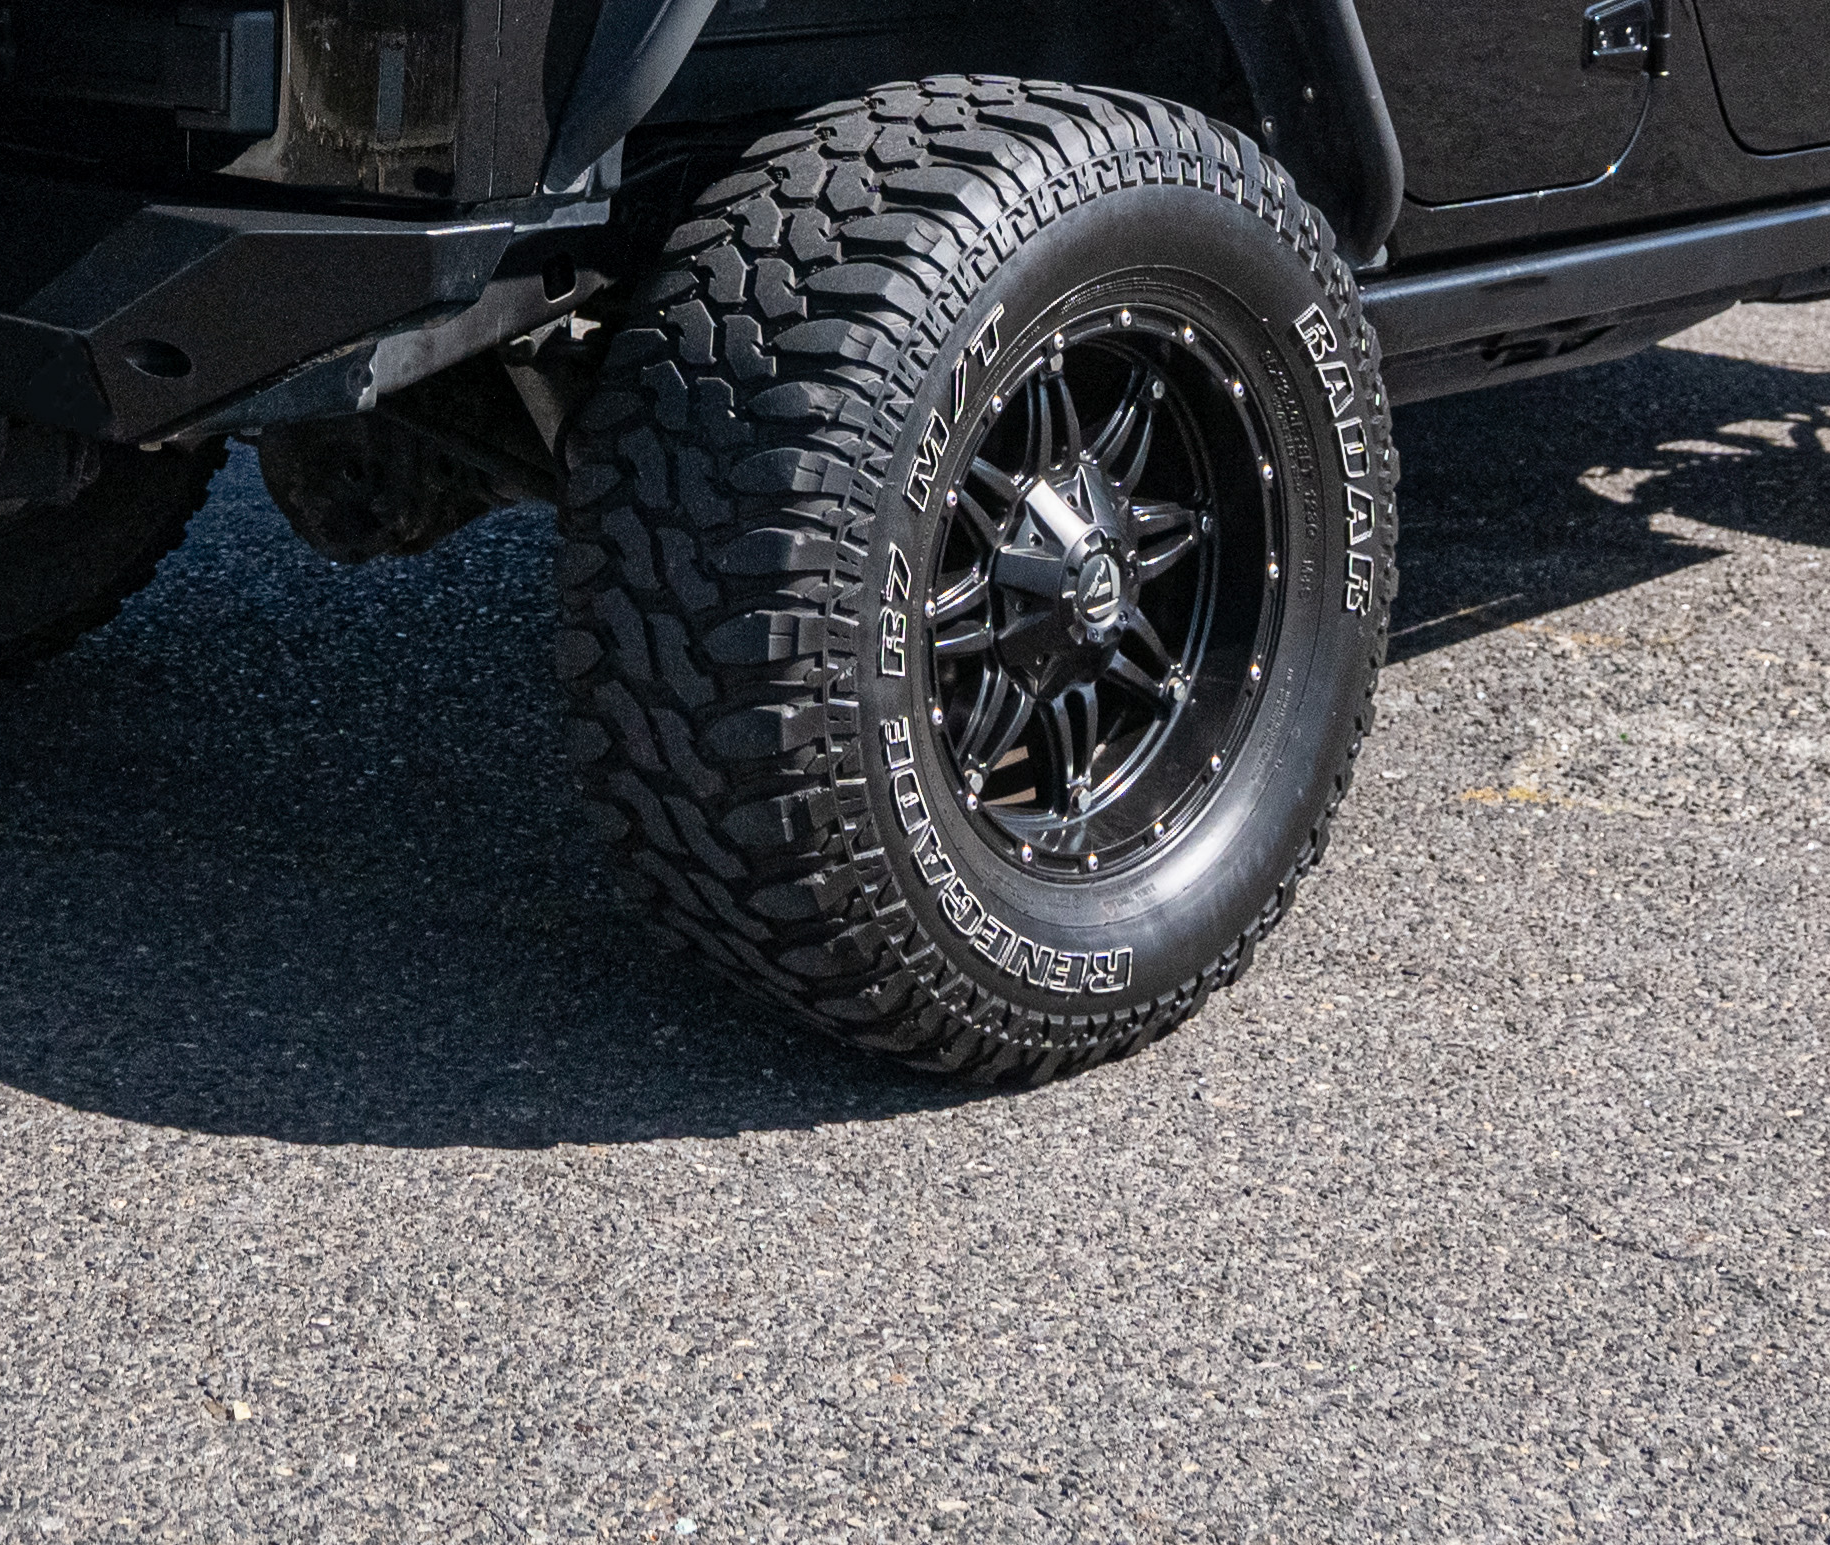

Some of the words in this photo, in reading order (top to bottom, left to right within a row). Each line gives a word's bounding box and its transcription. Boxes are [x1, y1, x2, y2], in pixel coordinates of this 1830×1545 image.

[905, 302, 1004, 513] M/T
[1294, 302, 1375, 617] RADAR
[880, 542, 913, 678] R7
[883, 716, 1133, 994] RENEGADE
